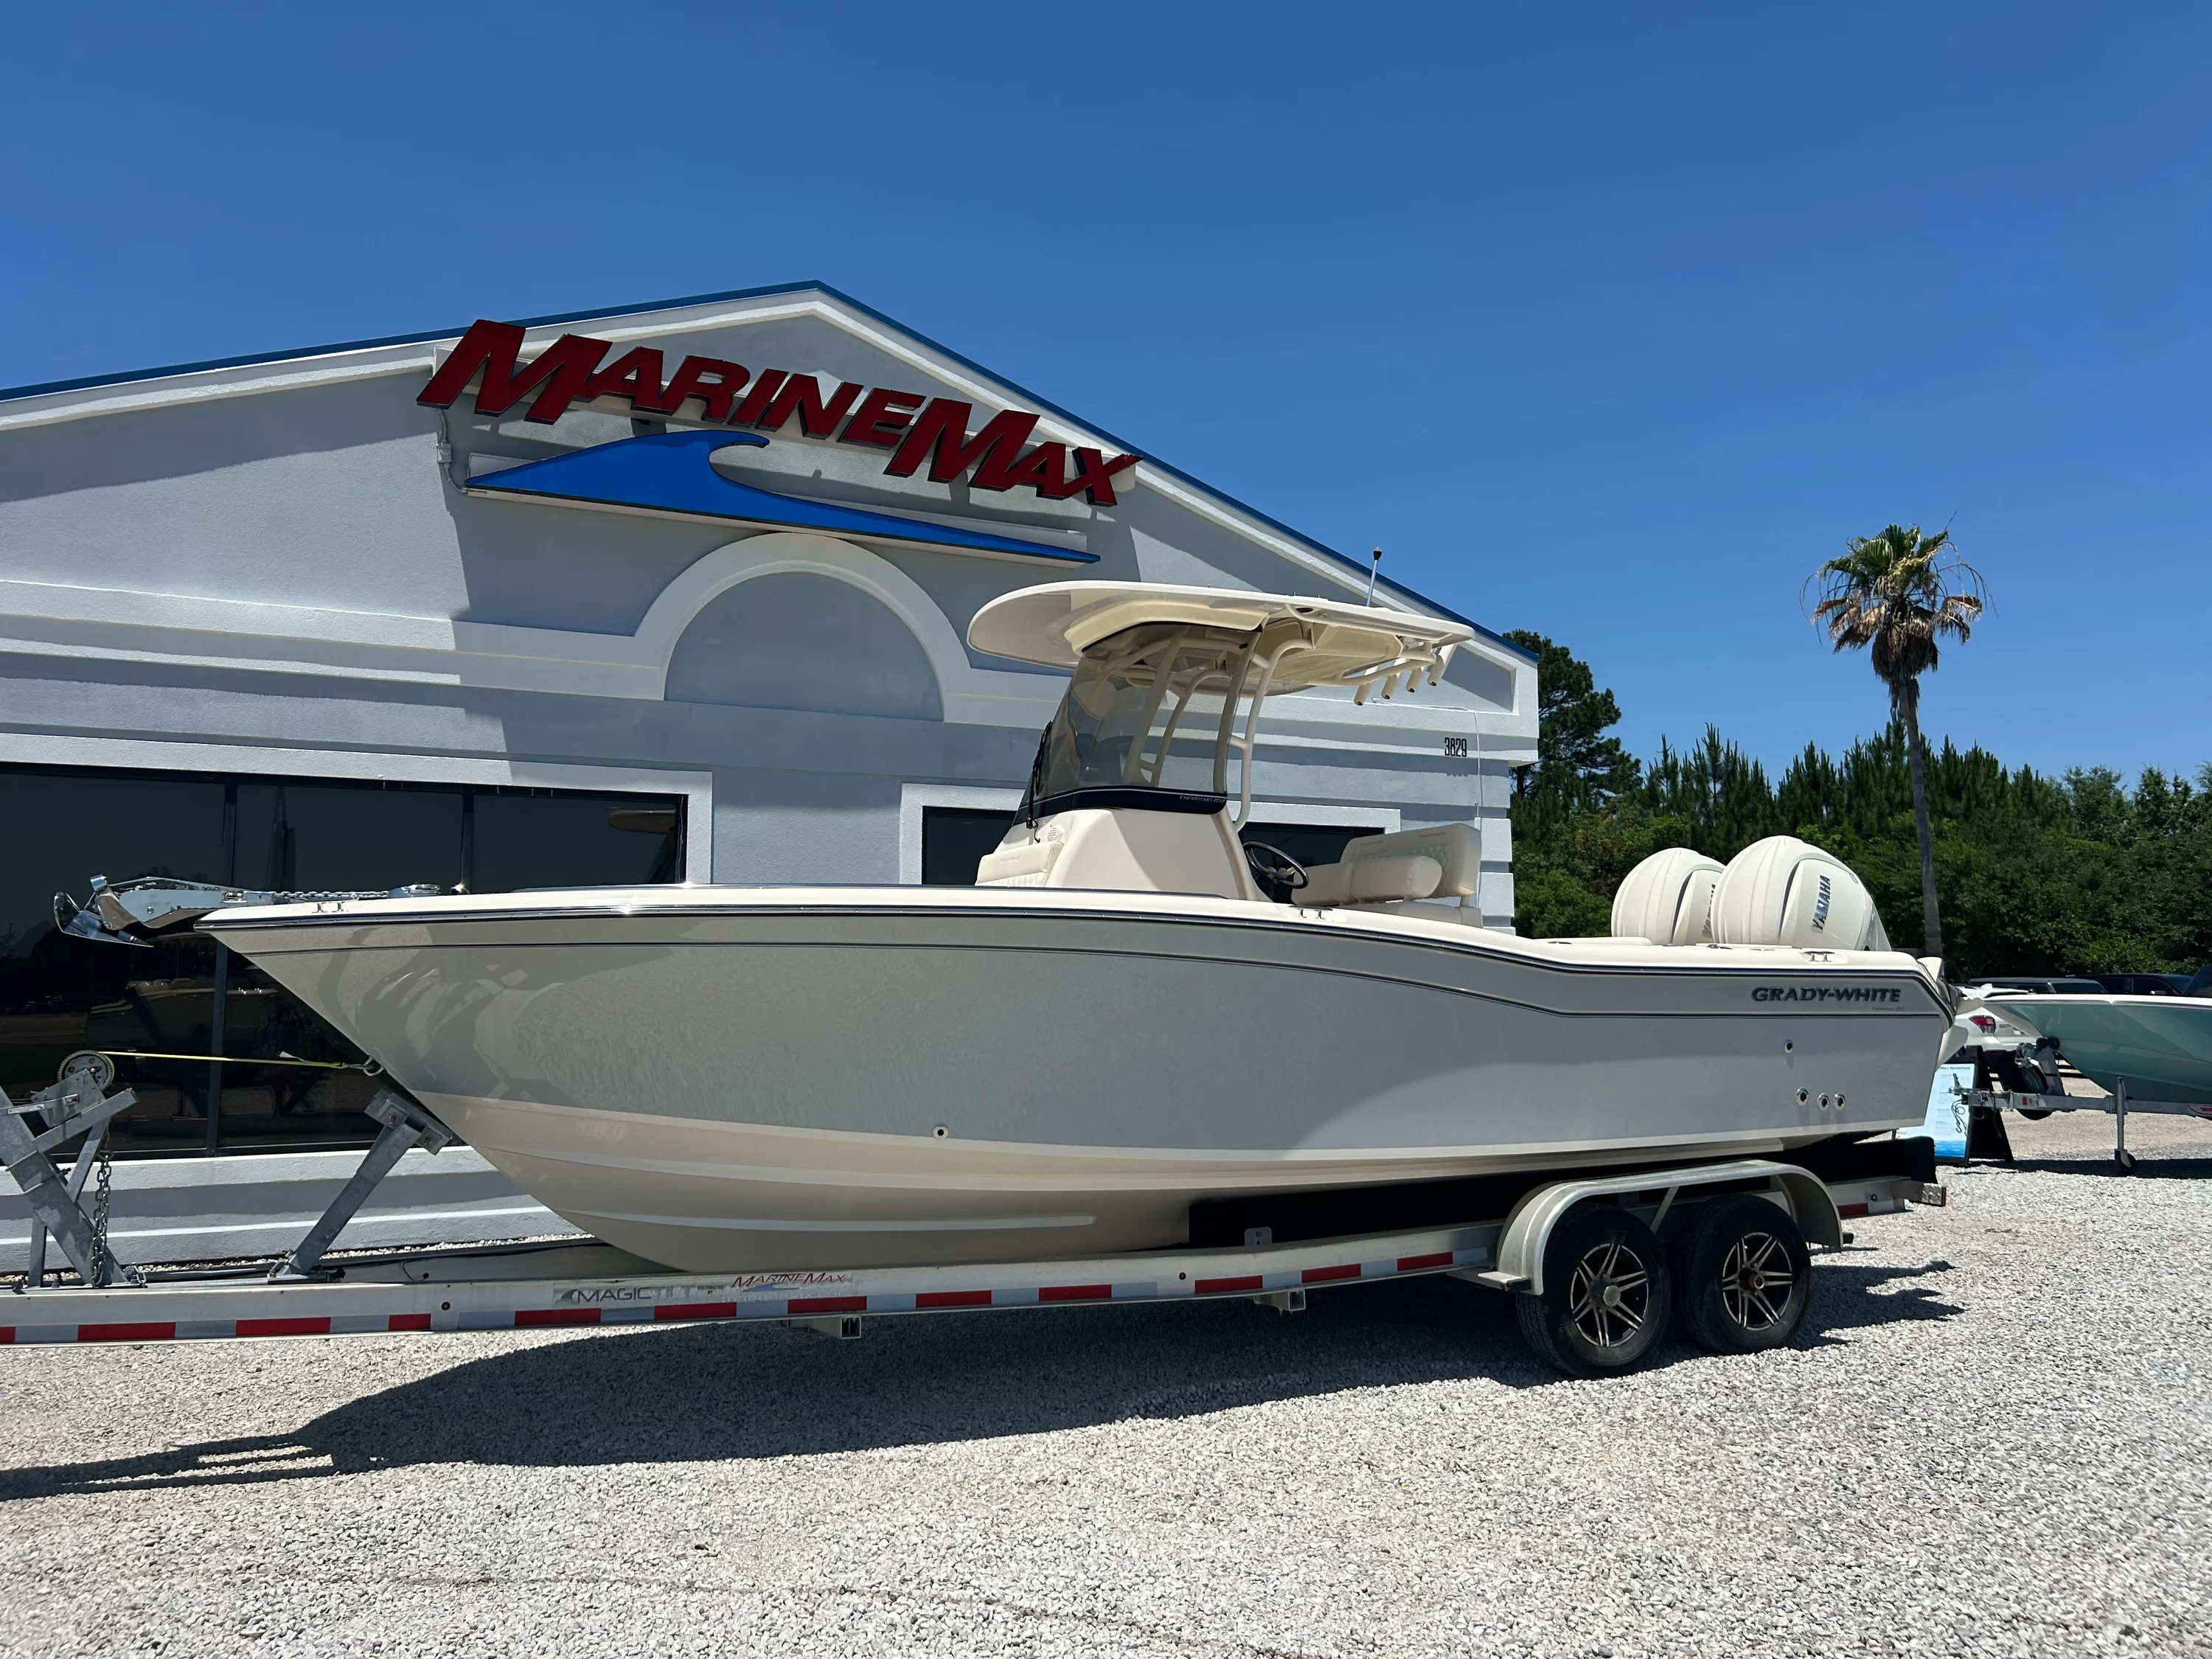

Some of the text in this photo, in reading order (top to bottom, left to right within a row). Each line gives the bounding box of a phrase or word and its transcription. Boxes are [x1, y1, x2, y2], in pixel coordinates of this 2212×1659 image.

[417, 319, 1143, 507] MARINEMAX
[1444, 737, 1467, 757] 3829
[1812, 874, 1831, 931] YAMAHA
[1750, 986, 1902, 1002] GRADY-WHITE
